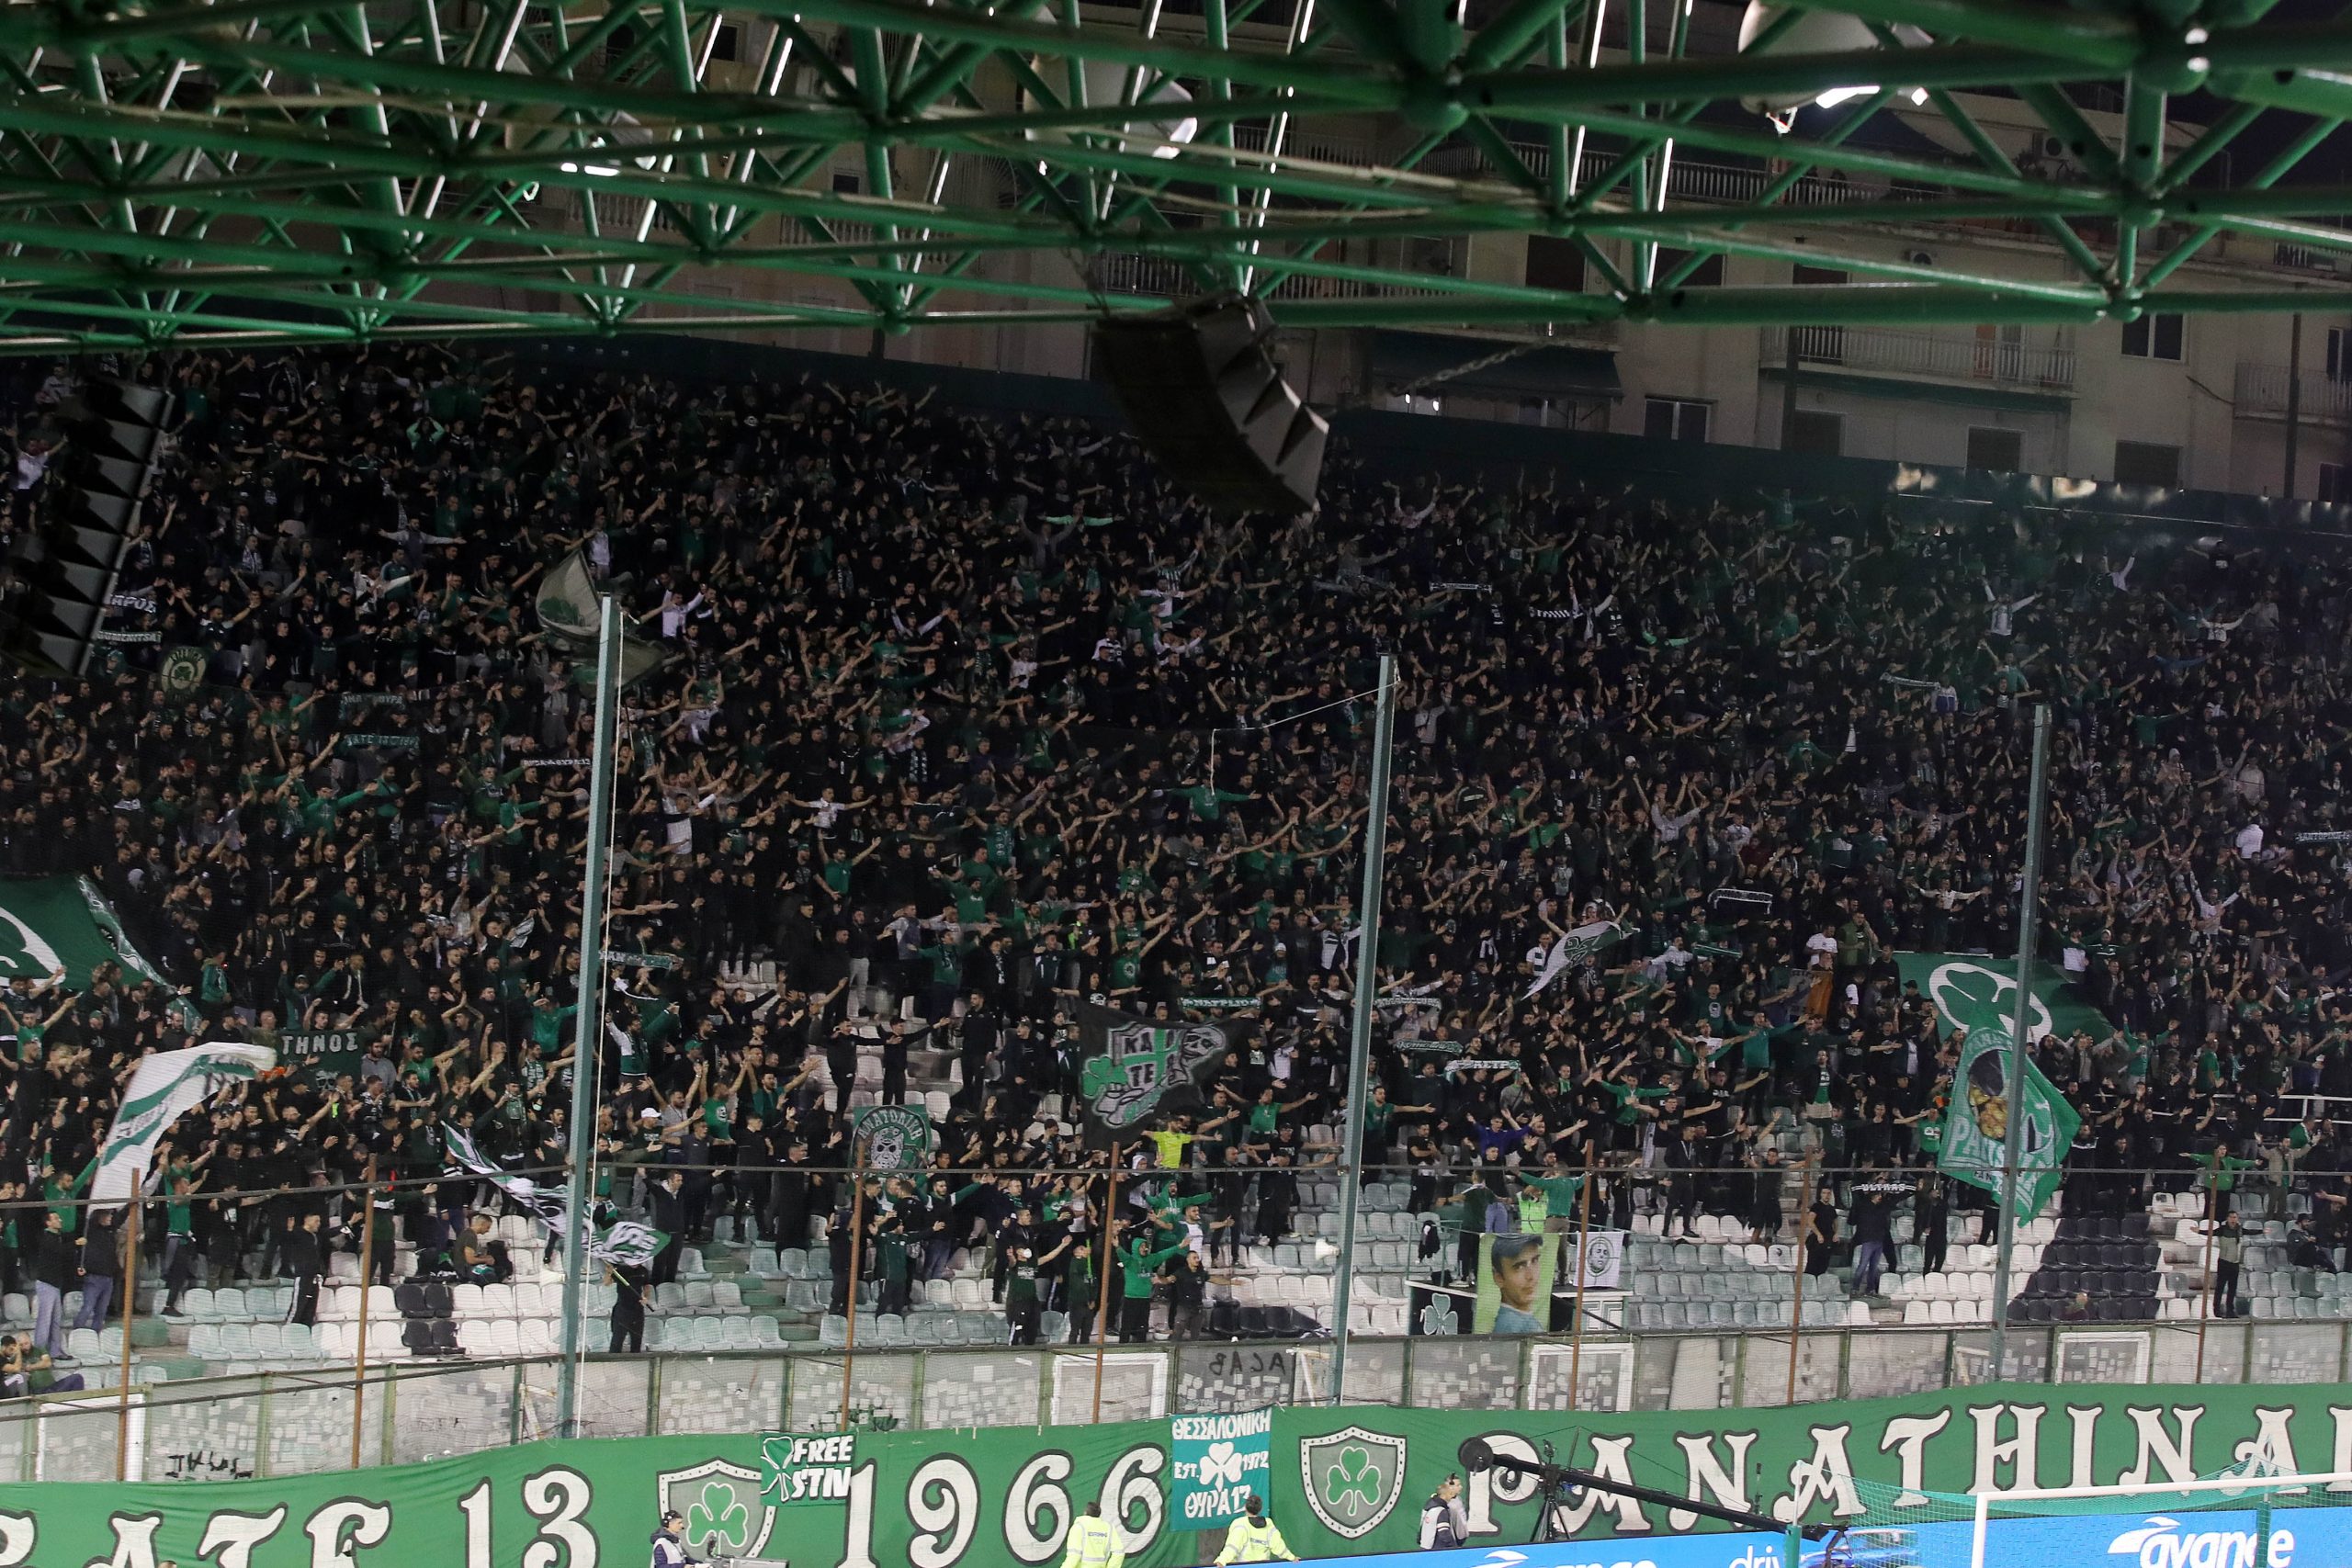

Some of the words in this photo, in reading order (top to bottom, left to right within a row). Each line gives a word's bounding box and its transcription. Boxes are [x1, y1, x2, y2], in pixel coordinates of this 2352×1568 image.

[281, 1032, 358, 1055] ΤΗΝΟΣ
[1172, 1407, 1272, 1440] ΘΕΣΣΑΛΟΝΙΚΗ
[793, 1435, 854, 1464] FREE
[1242, 1451, 1270, 1471] 1972
[458, 1463, 601, 1568] 13
[834, 1441, 1167, 1568] 1966
